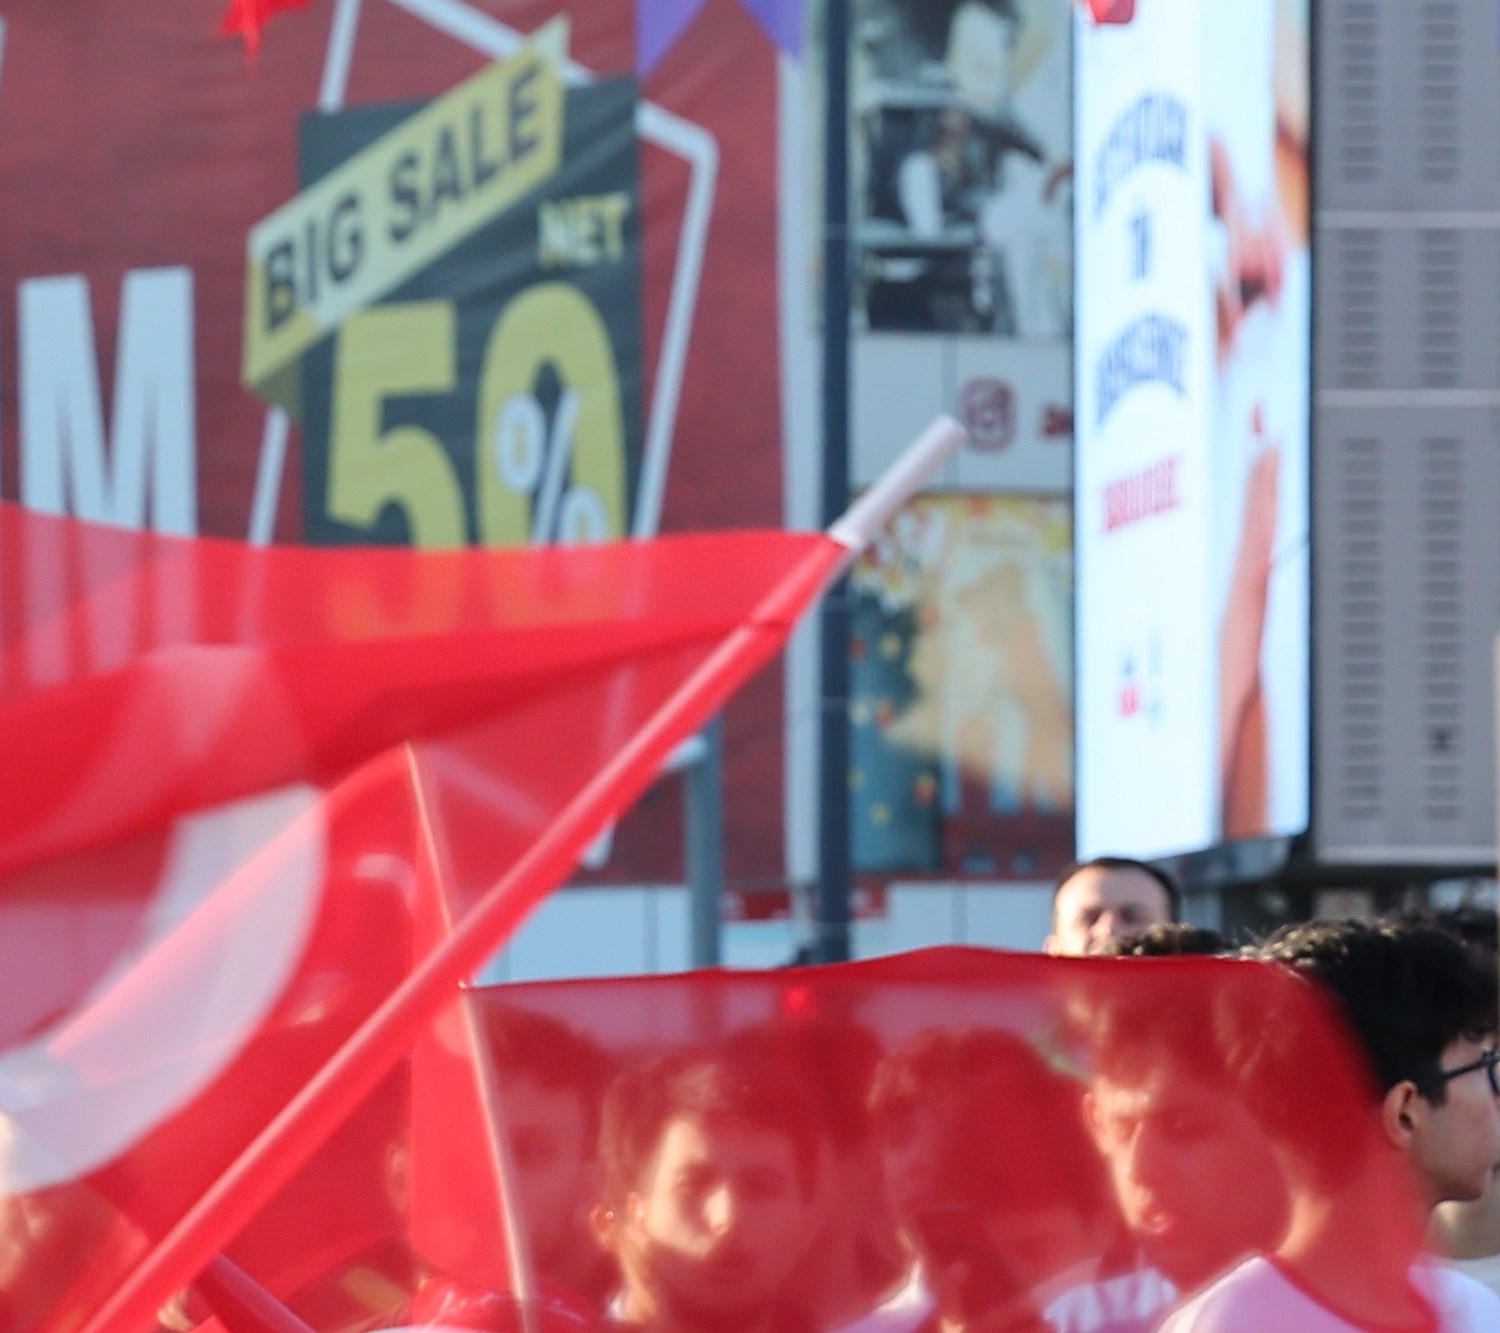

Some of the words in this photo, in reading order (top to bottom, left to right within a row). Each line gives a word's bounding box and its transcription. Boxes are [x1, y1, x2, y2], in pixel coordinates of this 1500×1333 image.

[264, 190, 365, 337] BIG
[386, 58, 547, 247] SALE
[537, 191, 632, 270] NET
